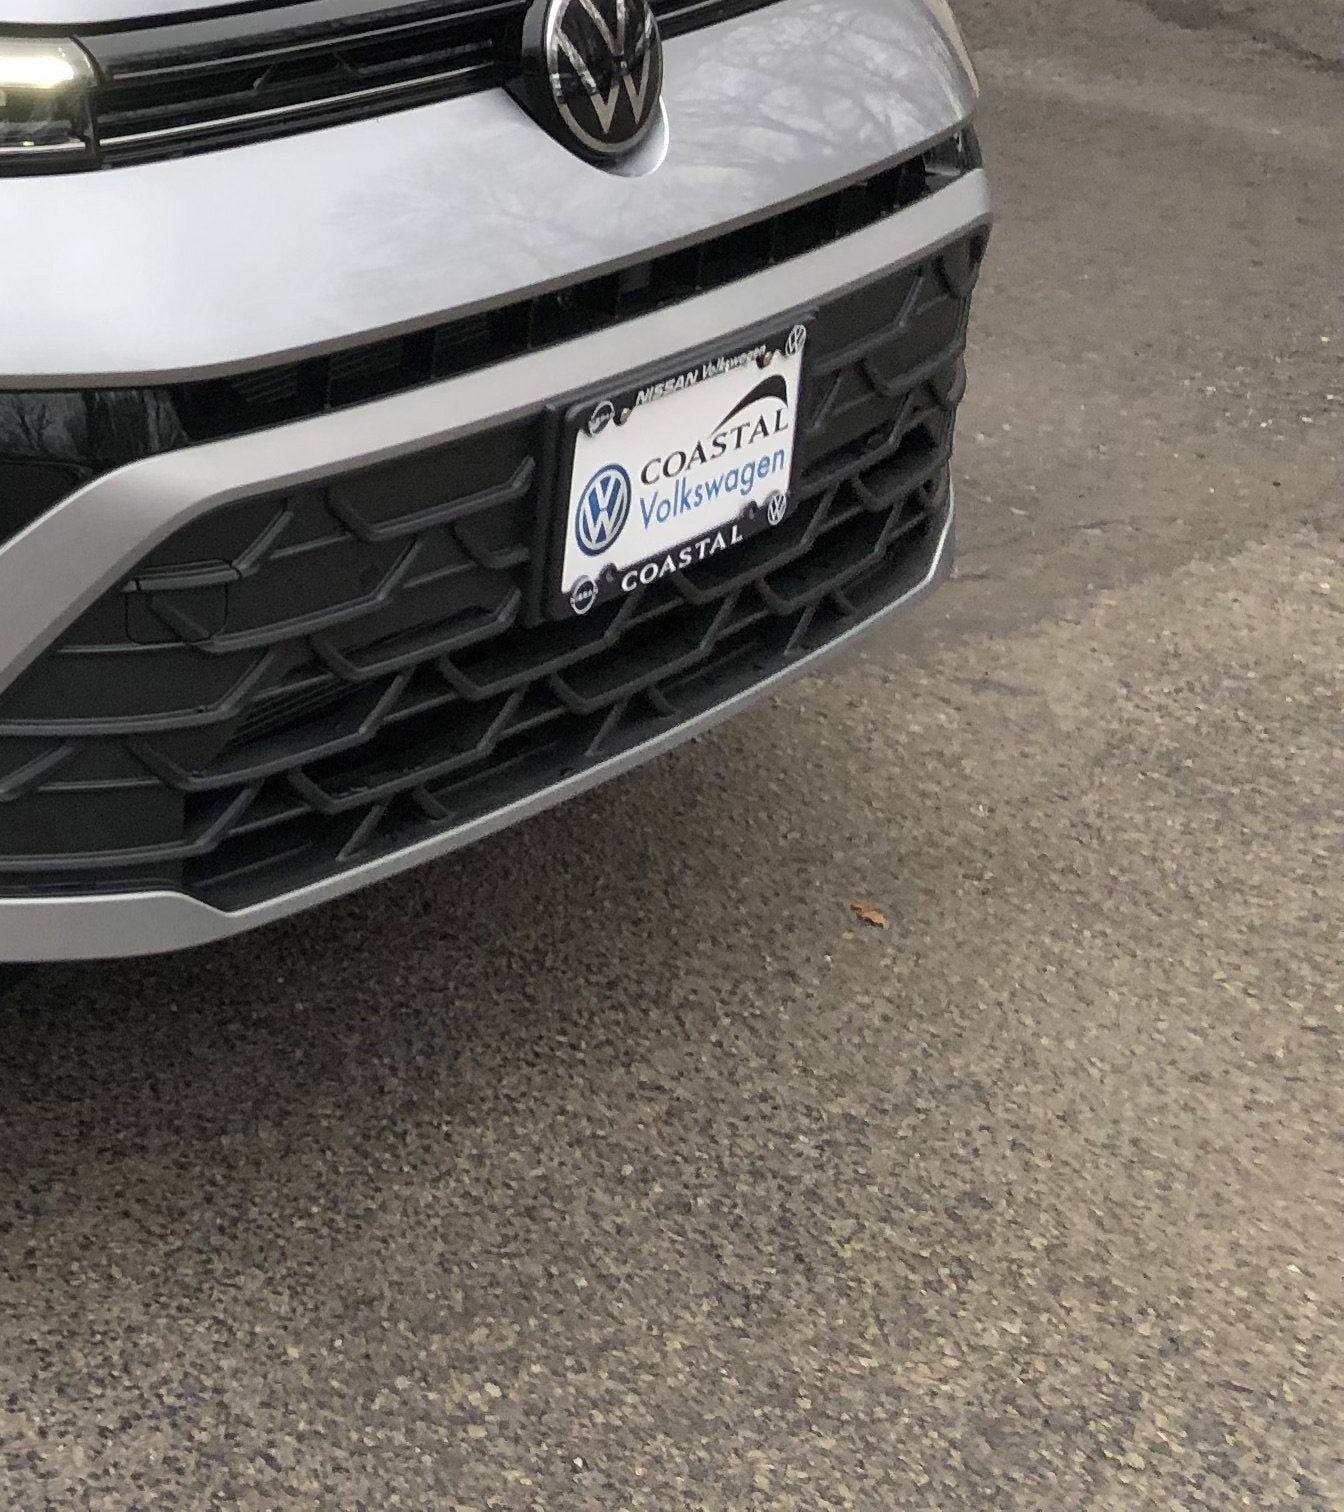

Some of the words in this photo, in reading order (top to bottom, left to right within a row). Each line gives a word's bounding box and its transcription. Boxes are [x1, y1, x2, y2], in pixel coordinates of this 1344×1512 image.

[635, 370, 698, 406] NISSAN
[640, 408, 789, 486] COASTAL
[639, 448, 786, 530] Volkswagen
[621, 524, 743, 593] COASTAL
